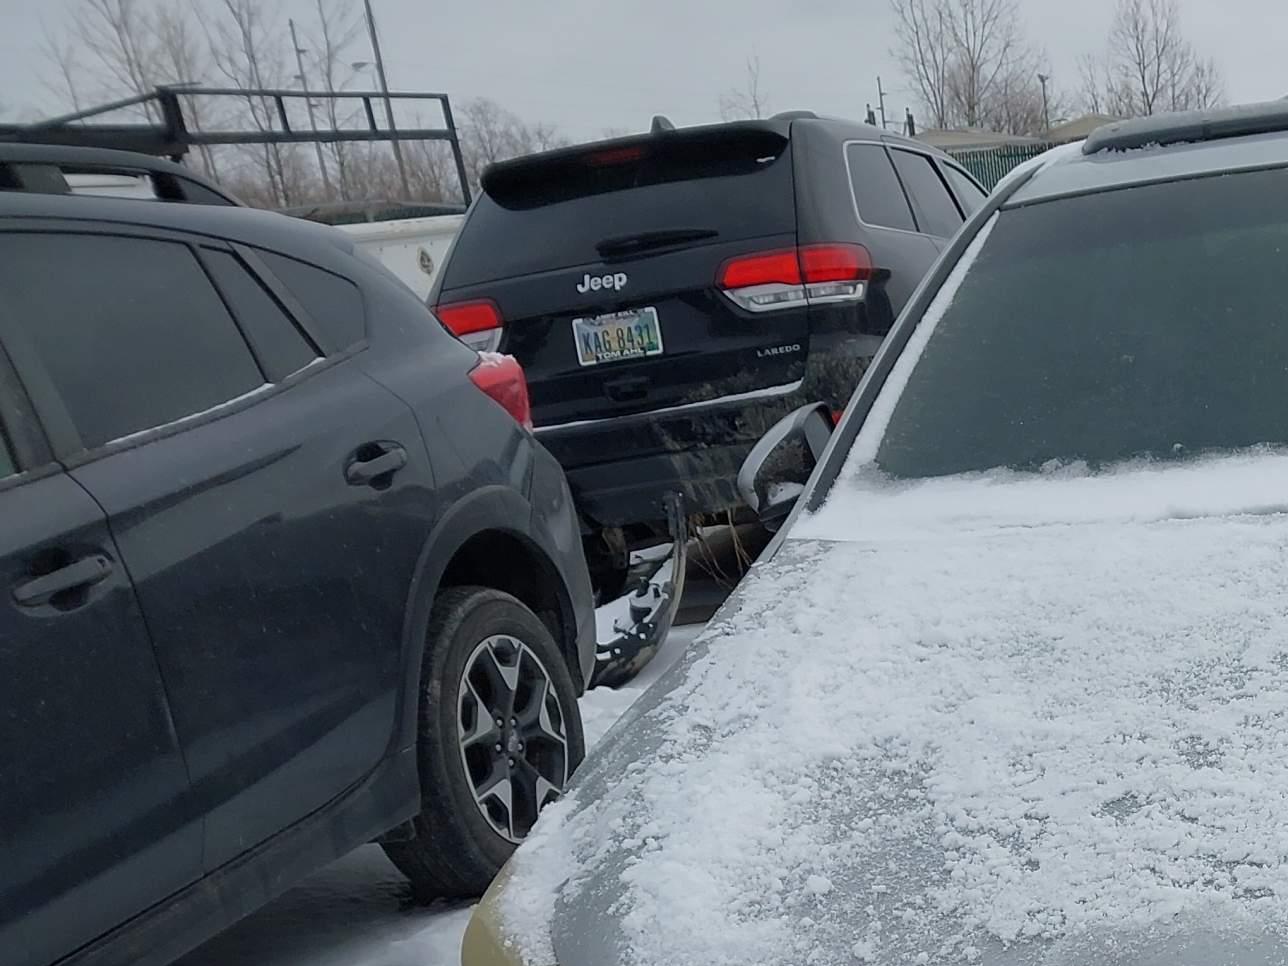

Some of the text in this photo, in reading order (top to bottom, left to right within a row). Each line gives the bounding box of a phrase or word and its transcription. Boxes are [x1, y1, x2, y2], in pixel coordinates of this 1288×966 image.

[576, 272, 628, 293] Jeep
[582, 323, 652, 354] KAG 8431
[597, 350, 621, 361] TOM
[756, 344, 801, 358] LAREDO
